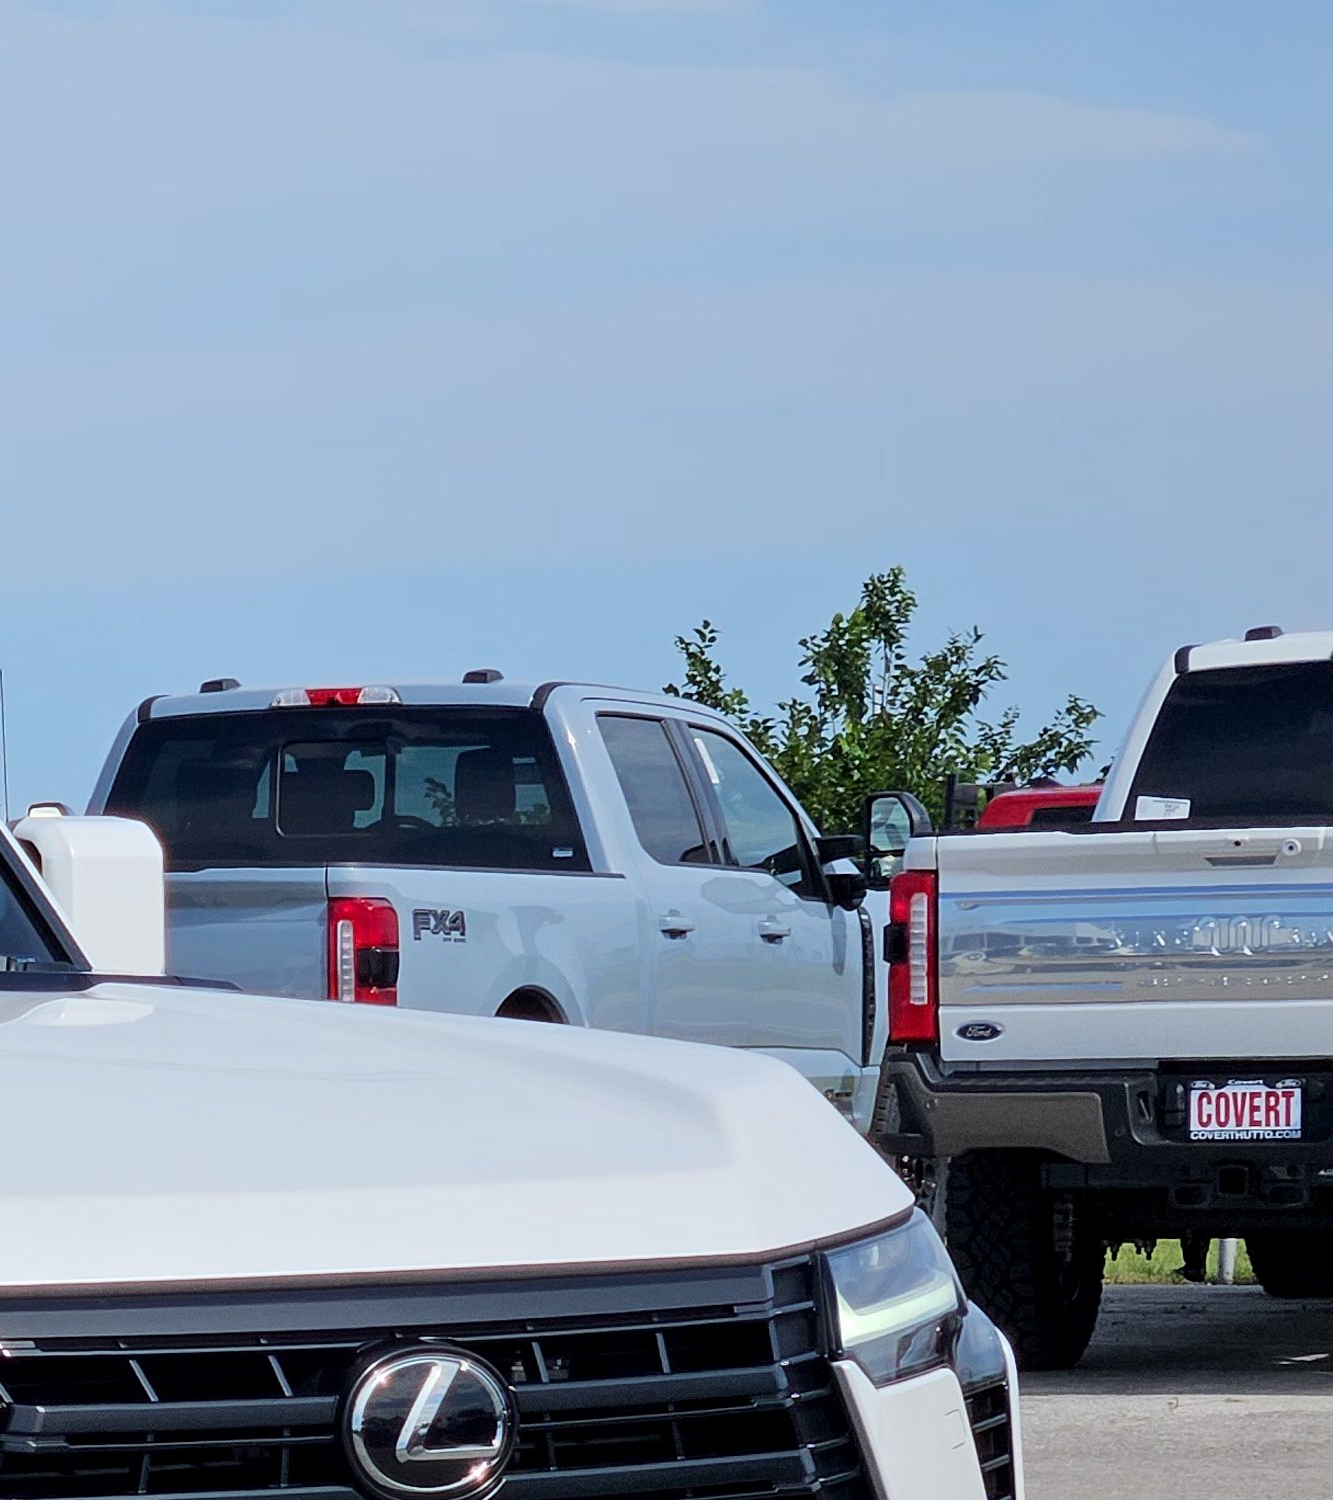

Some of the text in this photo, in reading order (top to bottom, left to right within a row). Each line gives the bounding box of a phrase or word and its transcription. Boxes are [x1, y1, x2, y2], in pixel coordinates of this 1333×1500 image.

[413, 909, 466, 941] FX4
[1197, 1091, 1295, 1128] COVERT
[1190, 1130, 1301, 1140] COVERTHUTTO.COM
